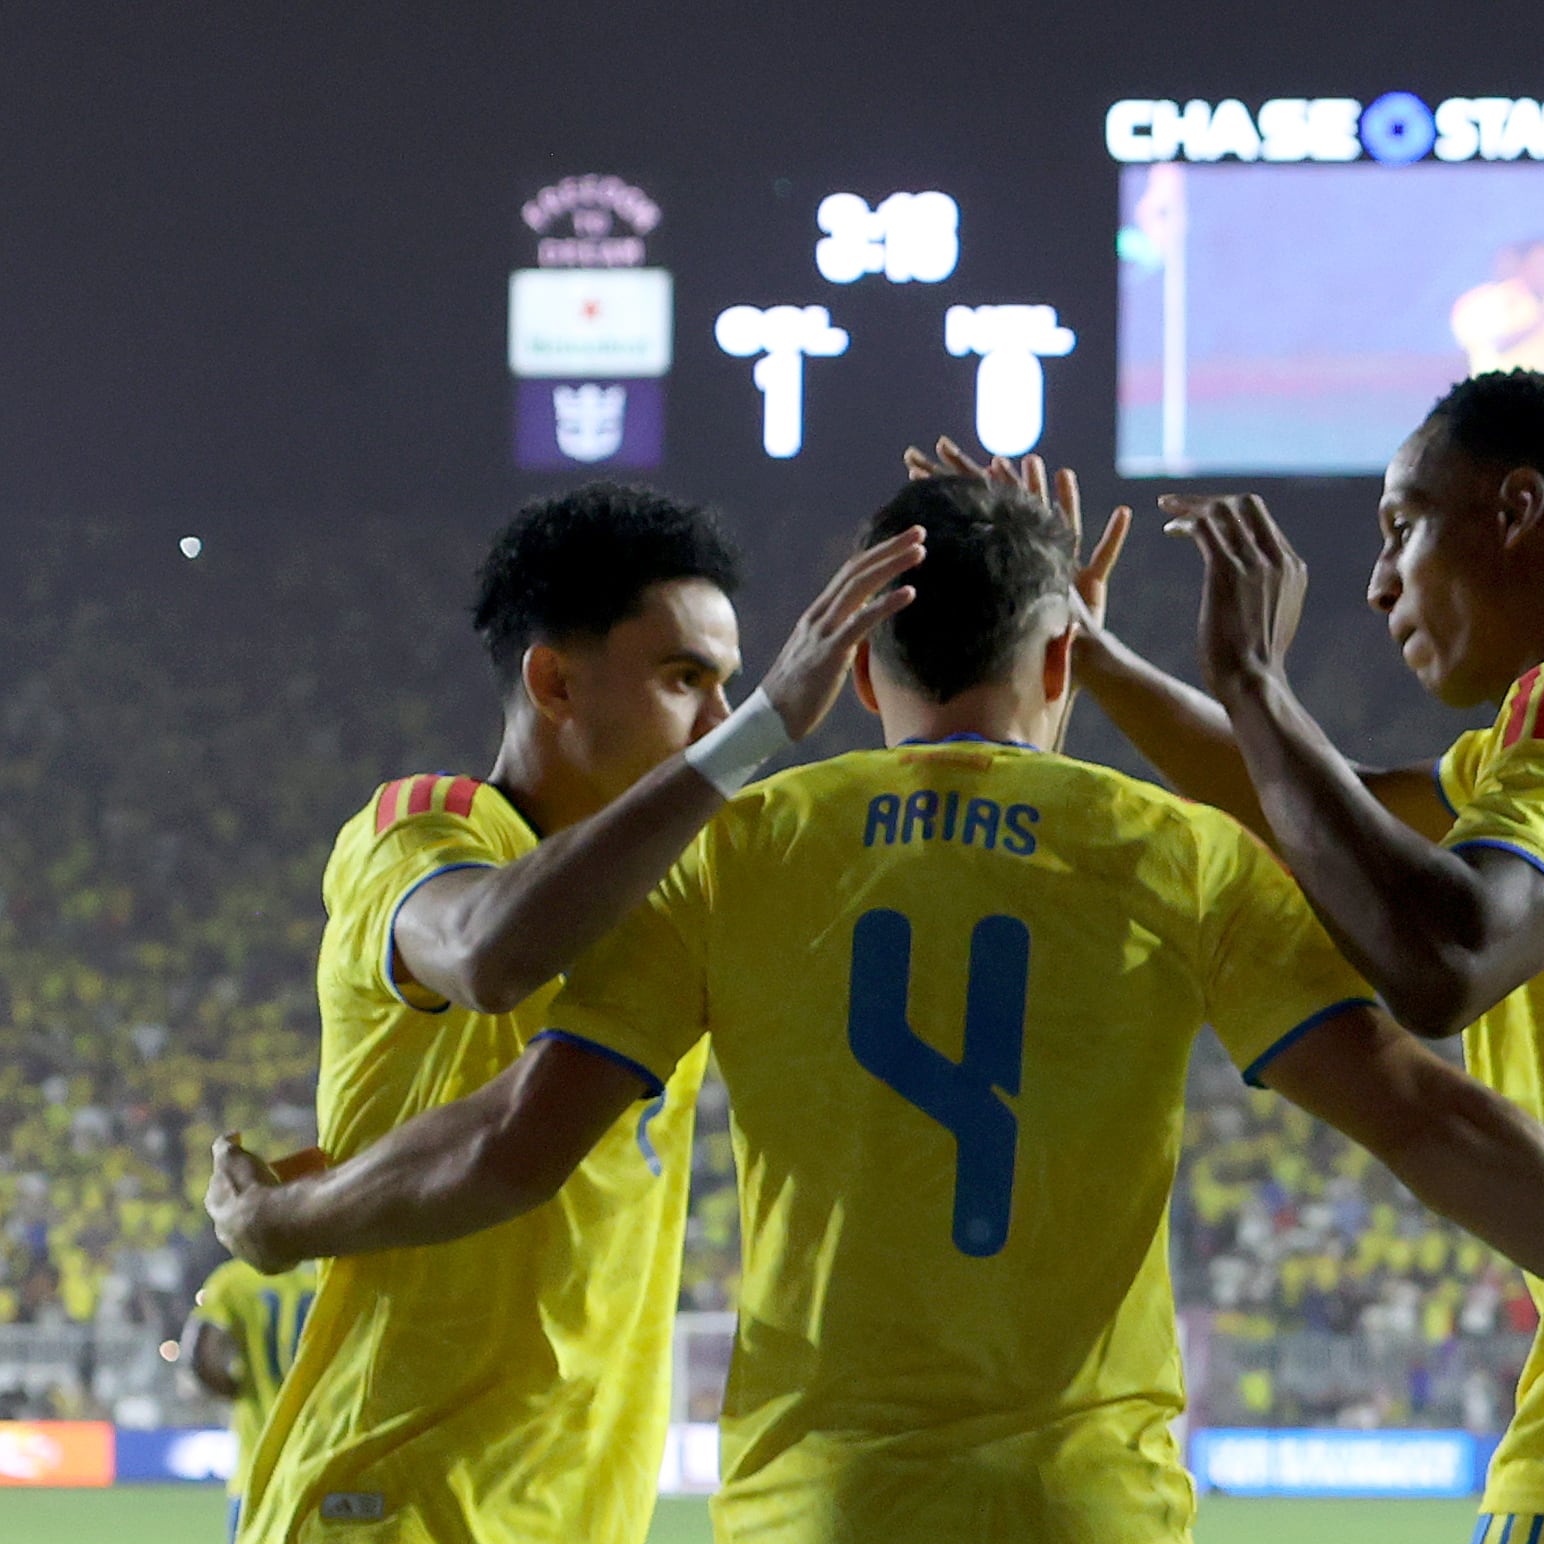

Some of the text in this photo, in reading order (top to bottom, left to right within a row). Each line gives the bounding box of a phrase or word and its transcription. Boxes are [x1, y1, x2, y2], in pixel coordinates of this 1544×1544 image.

[1105, 98, 1361, 162] CHASE
[863, 789, 1041, 856] ARIAS
[847, 907, 1031, 1258] 4
